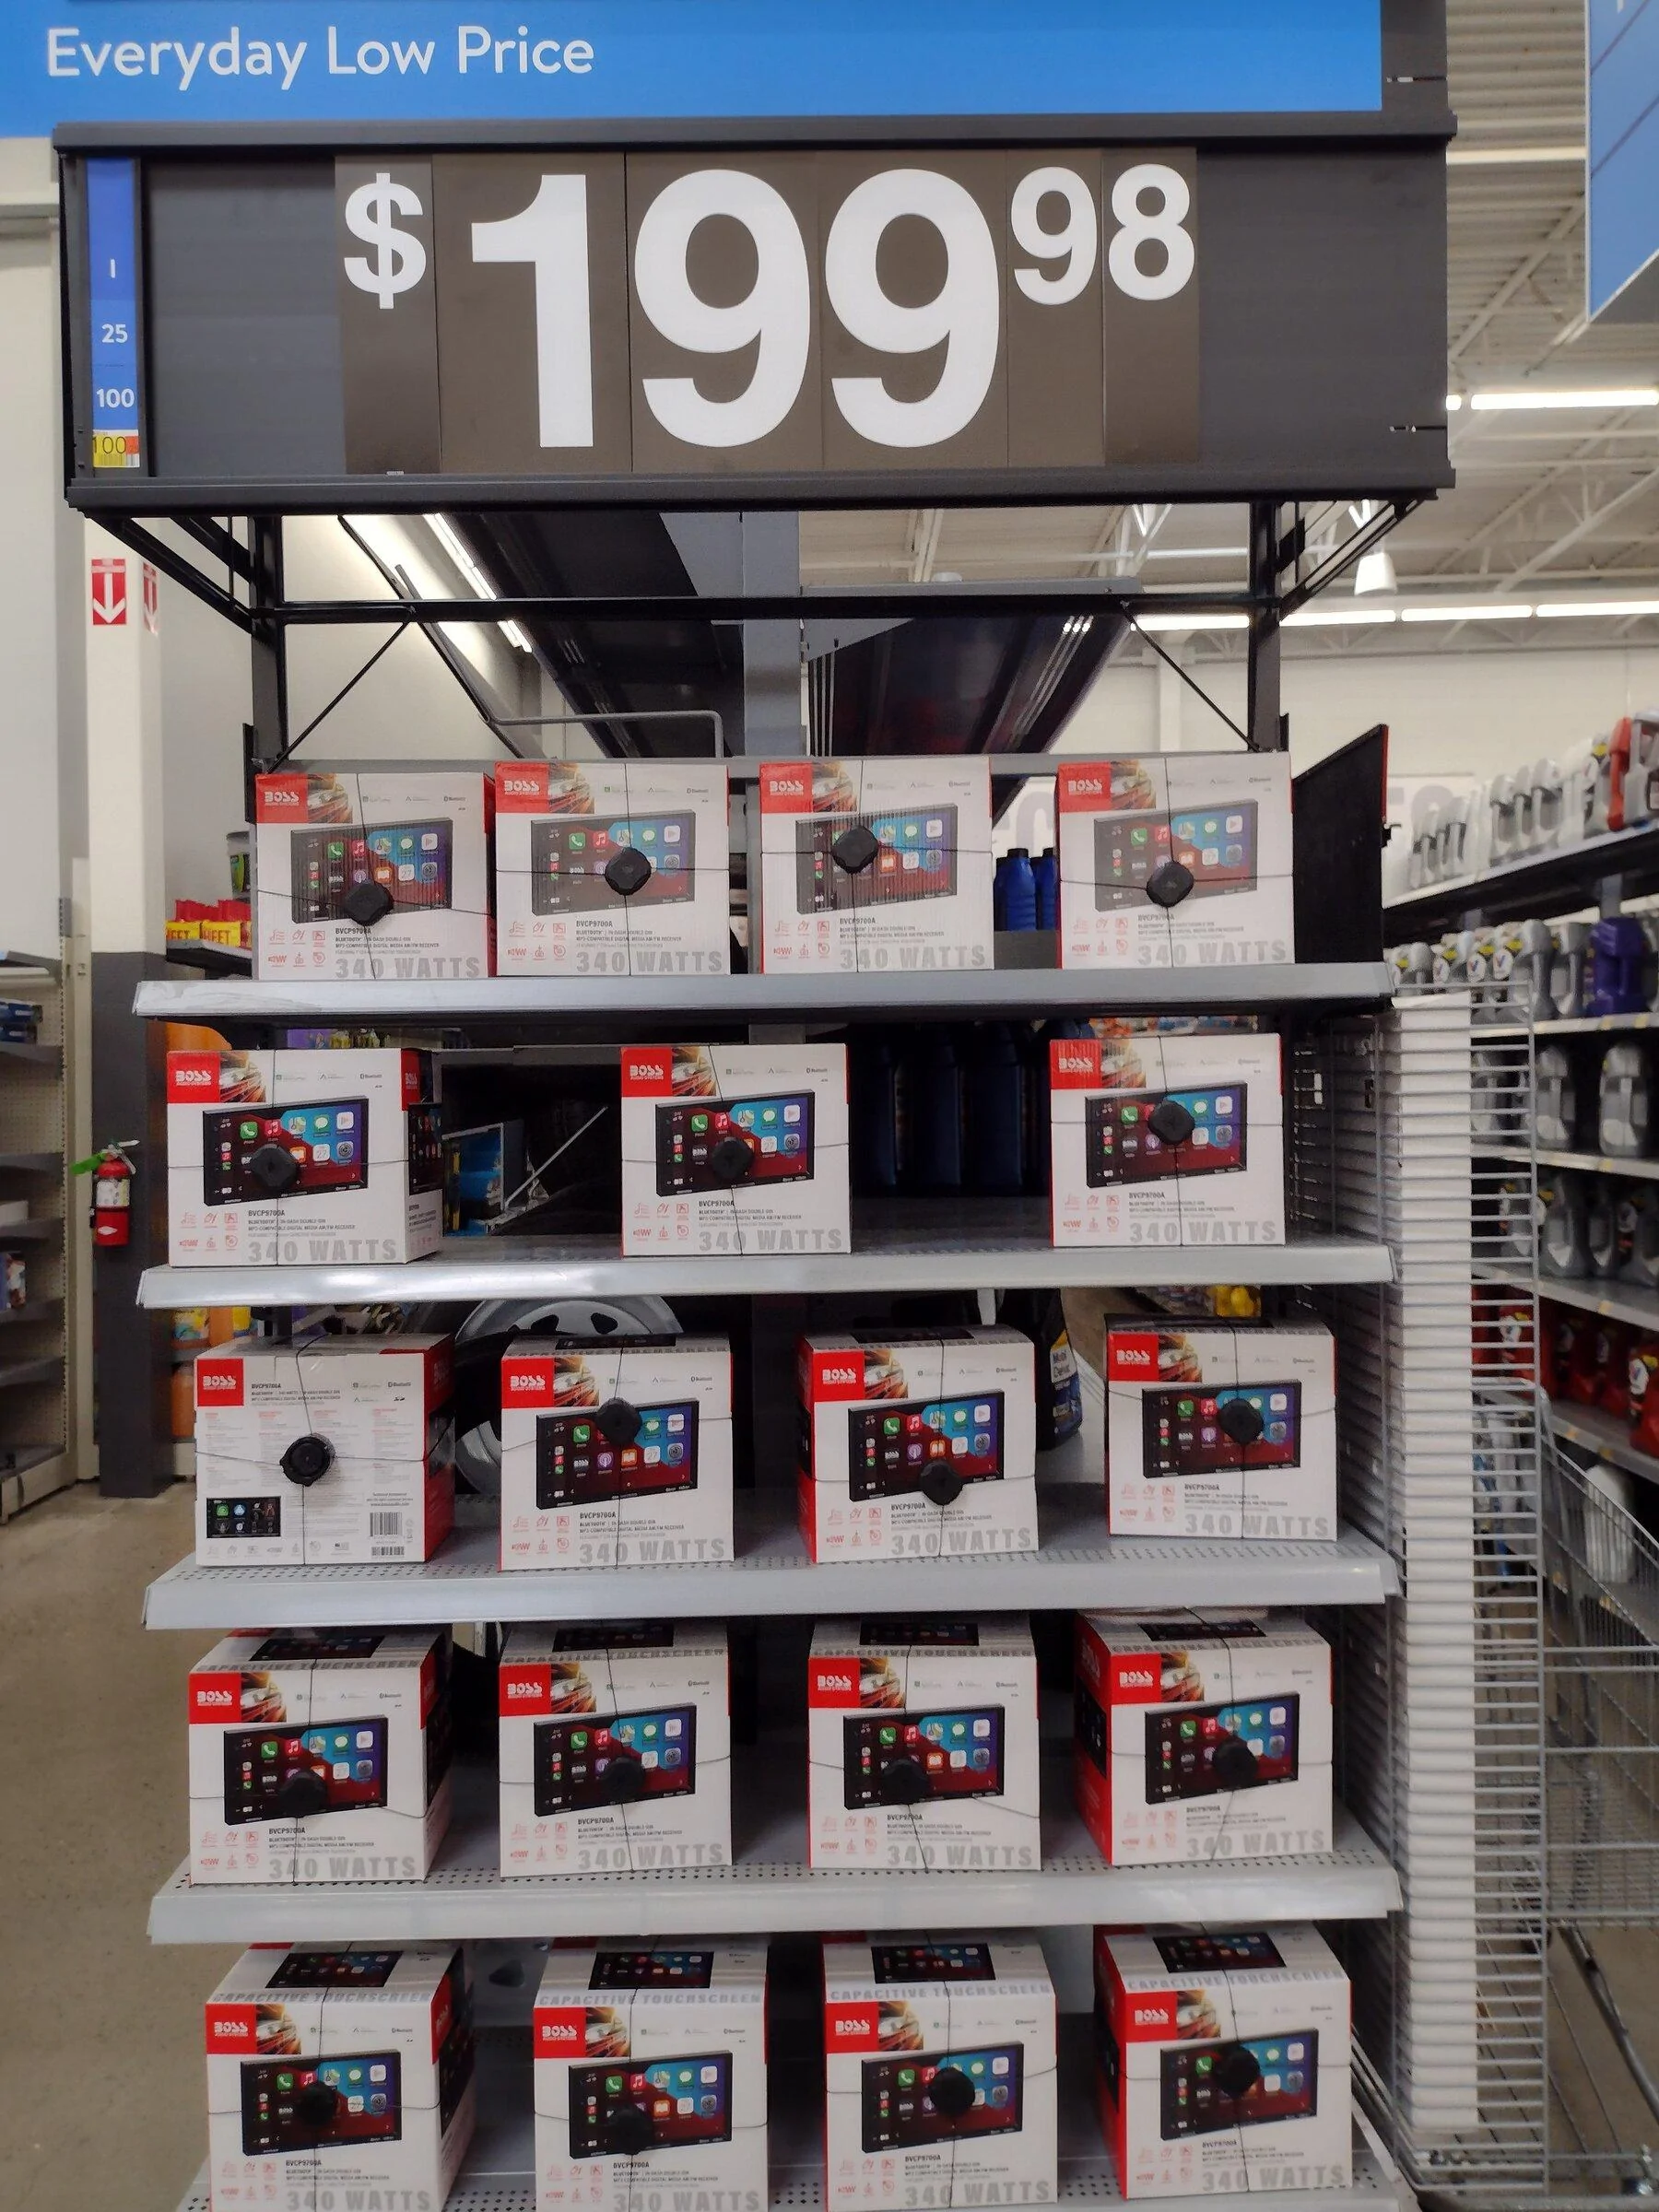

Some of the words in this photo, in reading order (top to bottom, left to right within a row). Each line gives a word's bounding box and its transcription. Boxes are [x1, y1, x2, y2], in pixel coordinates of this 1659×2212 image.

[47, 27, 307, 89] Everyday
[328, 26, 436, 75] Low
[458, 25, 594, 74] Price
[101, 324, 128, 344] 25
[96, 387, 135, 408] 100
[504, 781, 540, 793] BOSS
[769, 781, 804, 793] BOSS
[1067, 779, 1103, 793] BOSS
[264, 791, 300, 804] BOSS
[841, 947, 888, 970] 340
[900, 946, 986, 968] WATTS
[1138, 945, 1187, 965] 340
[1199, 940, 1287, 963] WATTS
[335, 959, 383, 978] 340
[394, 958, 480, 978] WATTS
[576, 952, 625, 972] 340
[636, 951, 723, 972] WATTS
[629, 1065, 664, 1077] BOSS
[1059, 1057, 1093, 1068] BOSS
[175, 1070, 212, 1082] BOSS
[699, 1230, 747, 1251] 340
[757, 1229, 841, 1251] WATTS
[1129, 1222, 1178, 1243] 340
[1189, 1221, 1276, 1242] WATTS
[248, 1241, 298, 1263] 340
[309, 1239, 396, 1261] WATTS
[1117, 1350, 1150, 1361] BOSS
[203, 1376, 237, 1386] BOSS
[511, 1375, 546, 1386] BOSS
[822, 1369, 856, 1380] BOSS
[1185, 1514, 1231, 1535] 340
[1243, 1515, 1328, 1536] WATTS
[891, 1534, 938, 1555] 340
[948, 1527, 1031, 1550] WATTS
[580, 1543, 628, 1563] 340
[640, 1538, 724, 1561] WATTS
[818, 1676, 852, 1687] BOSS
[1119, 1672, 1153, 1684] BOSS
[197, 1691, 232, 1702] BOSS
[508, 1683, 542, 1694] BOSS
[1187, 1836, 1232, 1857] 340
[1245, 1830, 1324, 1853] WATTS
[578, 1848, 627, 1869] 340
[637, 1843, 723, 1866] WATTS
[888, 1845, 935, 1866] 340
[947, 1845, 1032, 1866] WATTS
[269, 1858, 318, 1879] 340
[330, 1856, 415, 1878] WATTS
[539, 1995, 635, 2005] CAPACITIVE
[643, 1994, 760, 2004] TOUCHSCREEN
[830, 1989, 925, 2000] CAPACITIVE
[934, 1985, 1051, 1996] TOUCHSCREEN
[1135, 2009, 1169, 2022] BOSS
[214, 2022, 248, 2033] BOSS
[543, 2026, 577, 2037] BOSS
[835, 2020, 870, 2031] BOSS
[1203, 2171, 1248, 2192] 340
[1260, 2165, 1343, 2188] WATTS
[287, 2192, 335, 2211] 340
[347, 2191, 430, 2210] WATTS
[614, 2193, 662, 2212] 340
[673, 2191, 759, 2211] WATTS
[906, 2184, 953, 2206] 340
[964, 2181, 1050, 2203] WATTS
